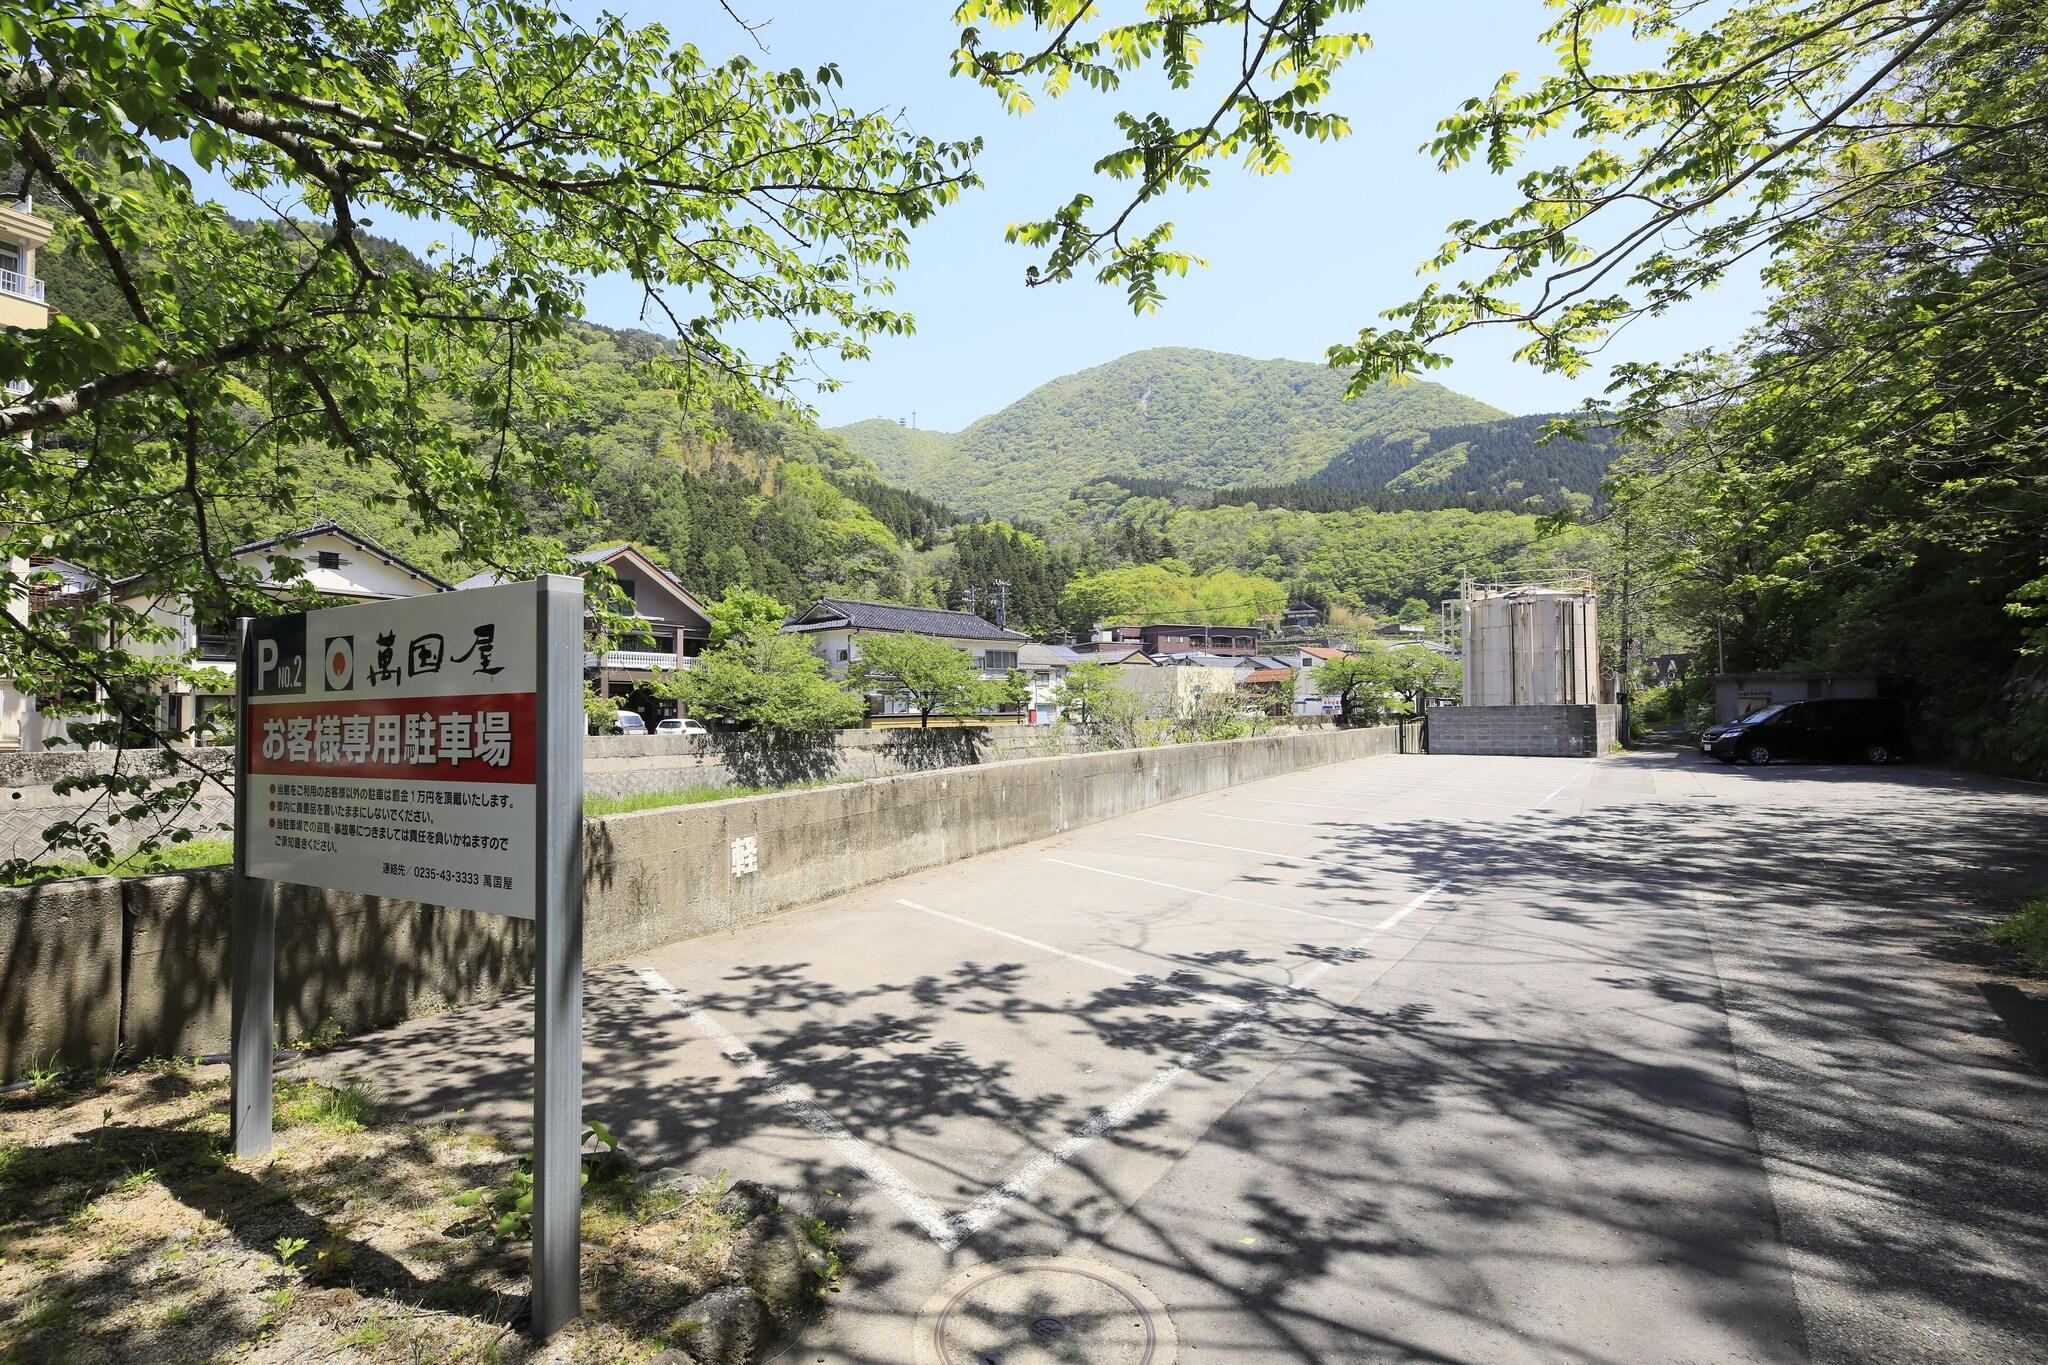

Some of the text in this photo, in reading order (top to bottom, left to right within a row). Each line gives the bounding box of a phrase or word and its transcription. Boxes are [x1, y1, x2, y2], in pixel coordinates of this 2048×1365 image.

[258, 638, 302, 691] P NO.2
[366, 624, 505, 687] 萬国屋
[262, 711, 513, 767] お客様専用駐車場
[413, 866, 480, 886] 0235-43-3333
[483, 874, 513, 891] 萬国屋
